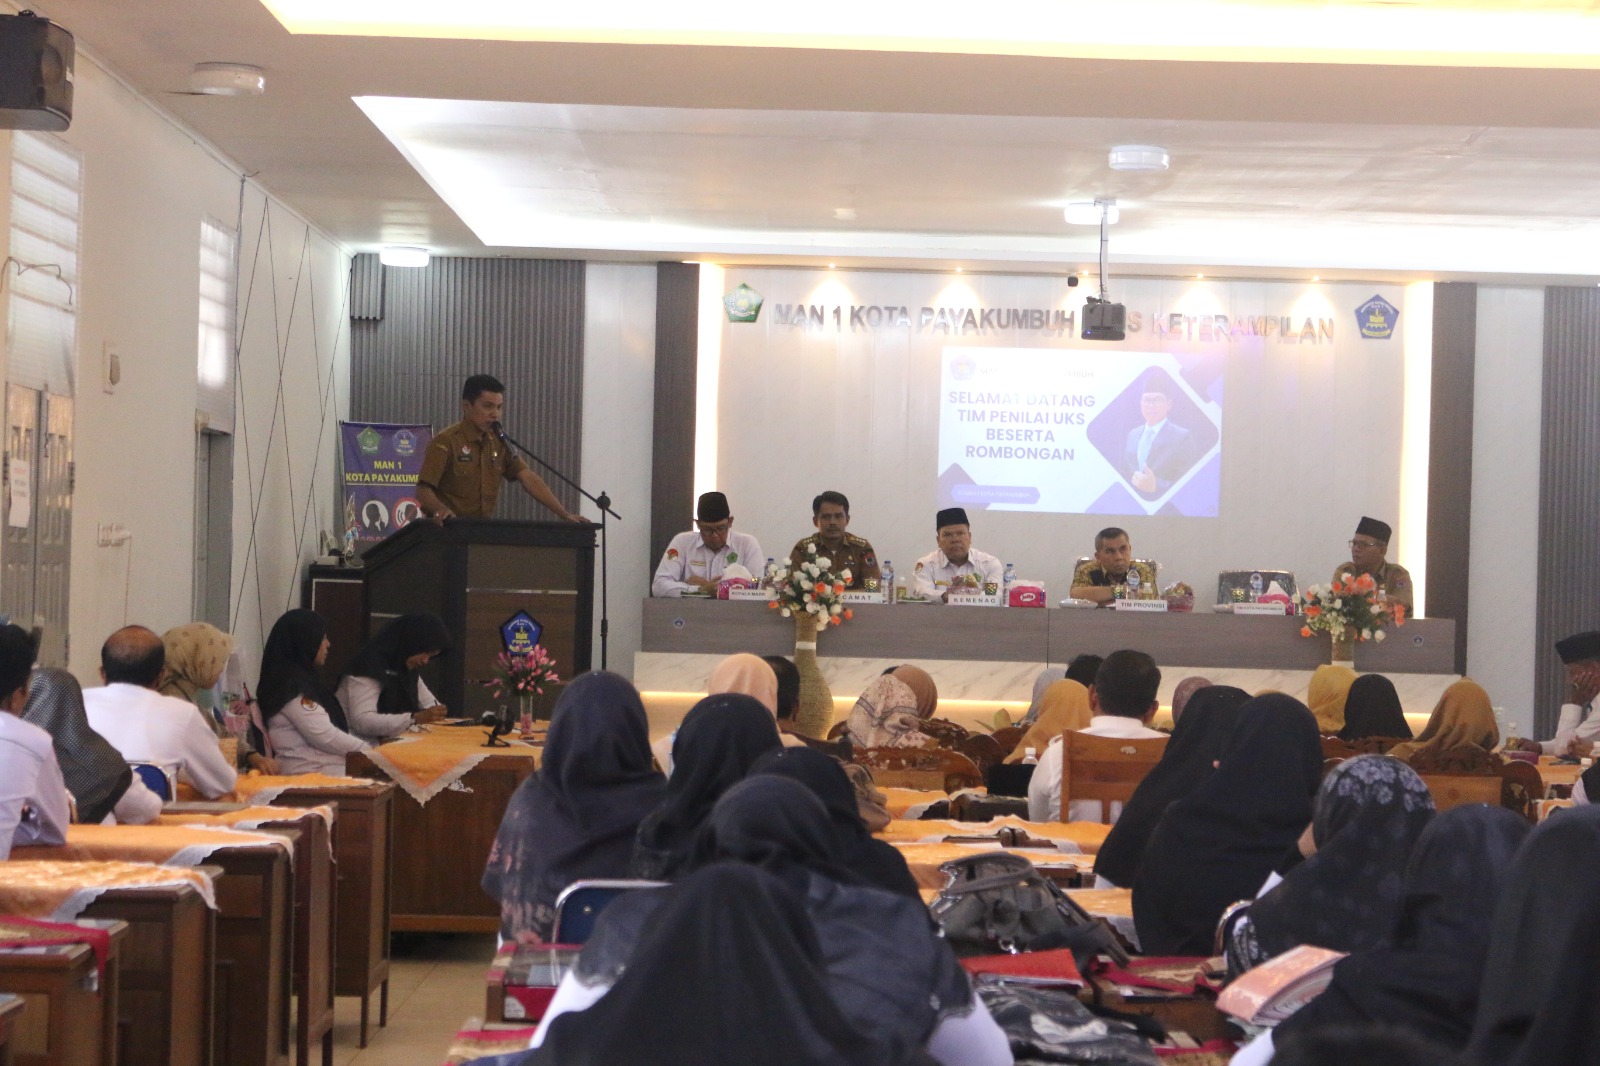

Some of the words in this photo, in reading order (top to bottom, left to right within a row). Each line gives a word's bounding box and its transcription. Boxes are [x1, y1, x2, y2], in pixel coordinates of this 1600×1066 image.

[774, 303, 825, 327] MAN
[832, 305, 842, 327] 1
[850, 305, 912, 328] KOTA
[920, 306, 1075, 331] PAYAKUMBUH
[1152, 311, 1335, 338] KETERAMPILAN
[948, 391, 1020, 405] SELAMAT
[1026, 394, 1096, 408] DATANG
[957, 409, 986, 422] TIM
[989, 410, 1049, 424] PENILAI
[1053, 412, 1086, 425] UKS
[986, 428, 1056, 442] BESERTA
[965, 445, 1075, 461] ROMBONGAN
[373, 460, 395, 470] MAN
[398, 461, 402, 470] 1
[345, 473, 371, 483] KOTA
